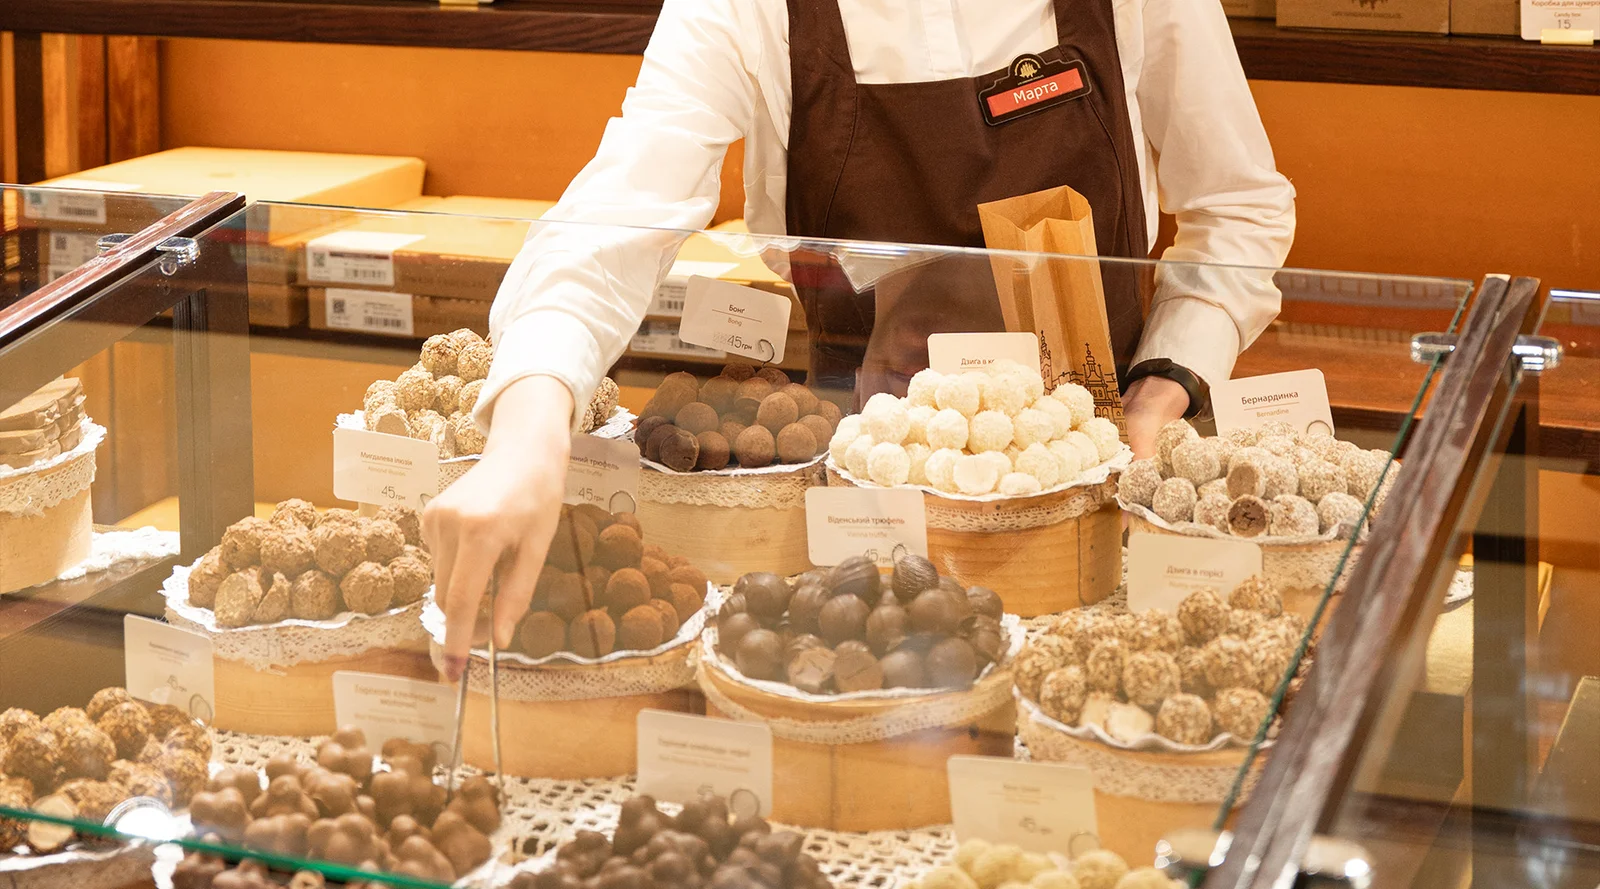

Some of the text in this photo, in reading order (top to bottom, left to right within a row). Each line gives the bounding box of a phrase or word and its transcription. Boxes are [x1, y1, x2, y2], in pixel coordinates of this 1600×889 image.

[1557, 19, 1572, 29] 15
[1013, 81, 1059, 103] Марта
[727, 317, 743, 327] Bong
[1241, 391, 1299, 405] Бернардинка
[1256, 408, 1290, 418] Bernardine
[590, 459, 619, 471] трюфель
[872, 516, 905, 527] трюфель
